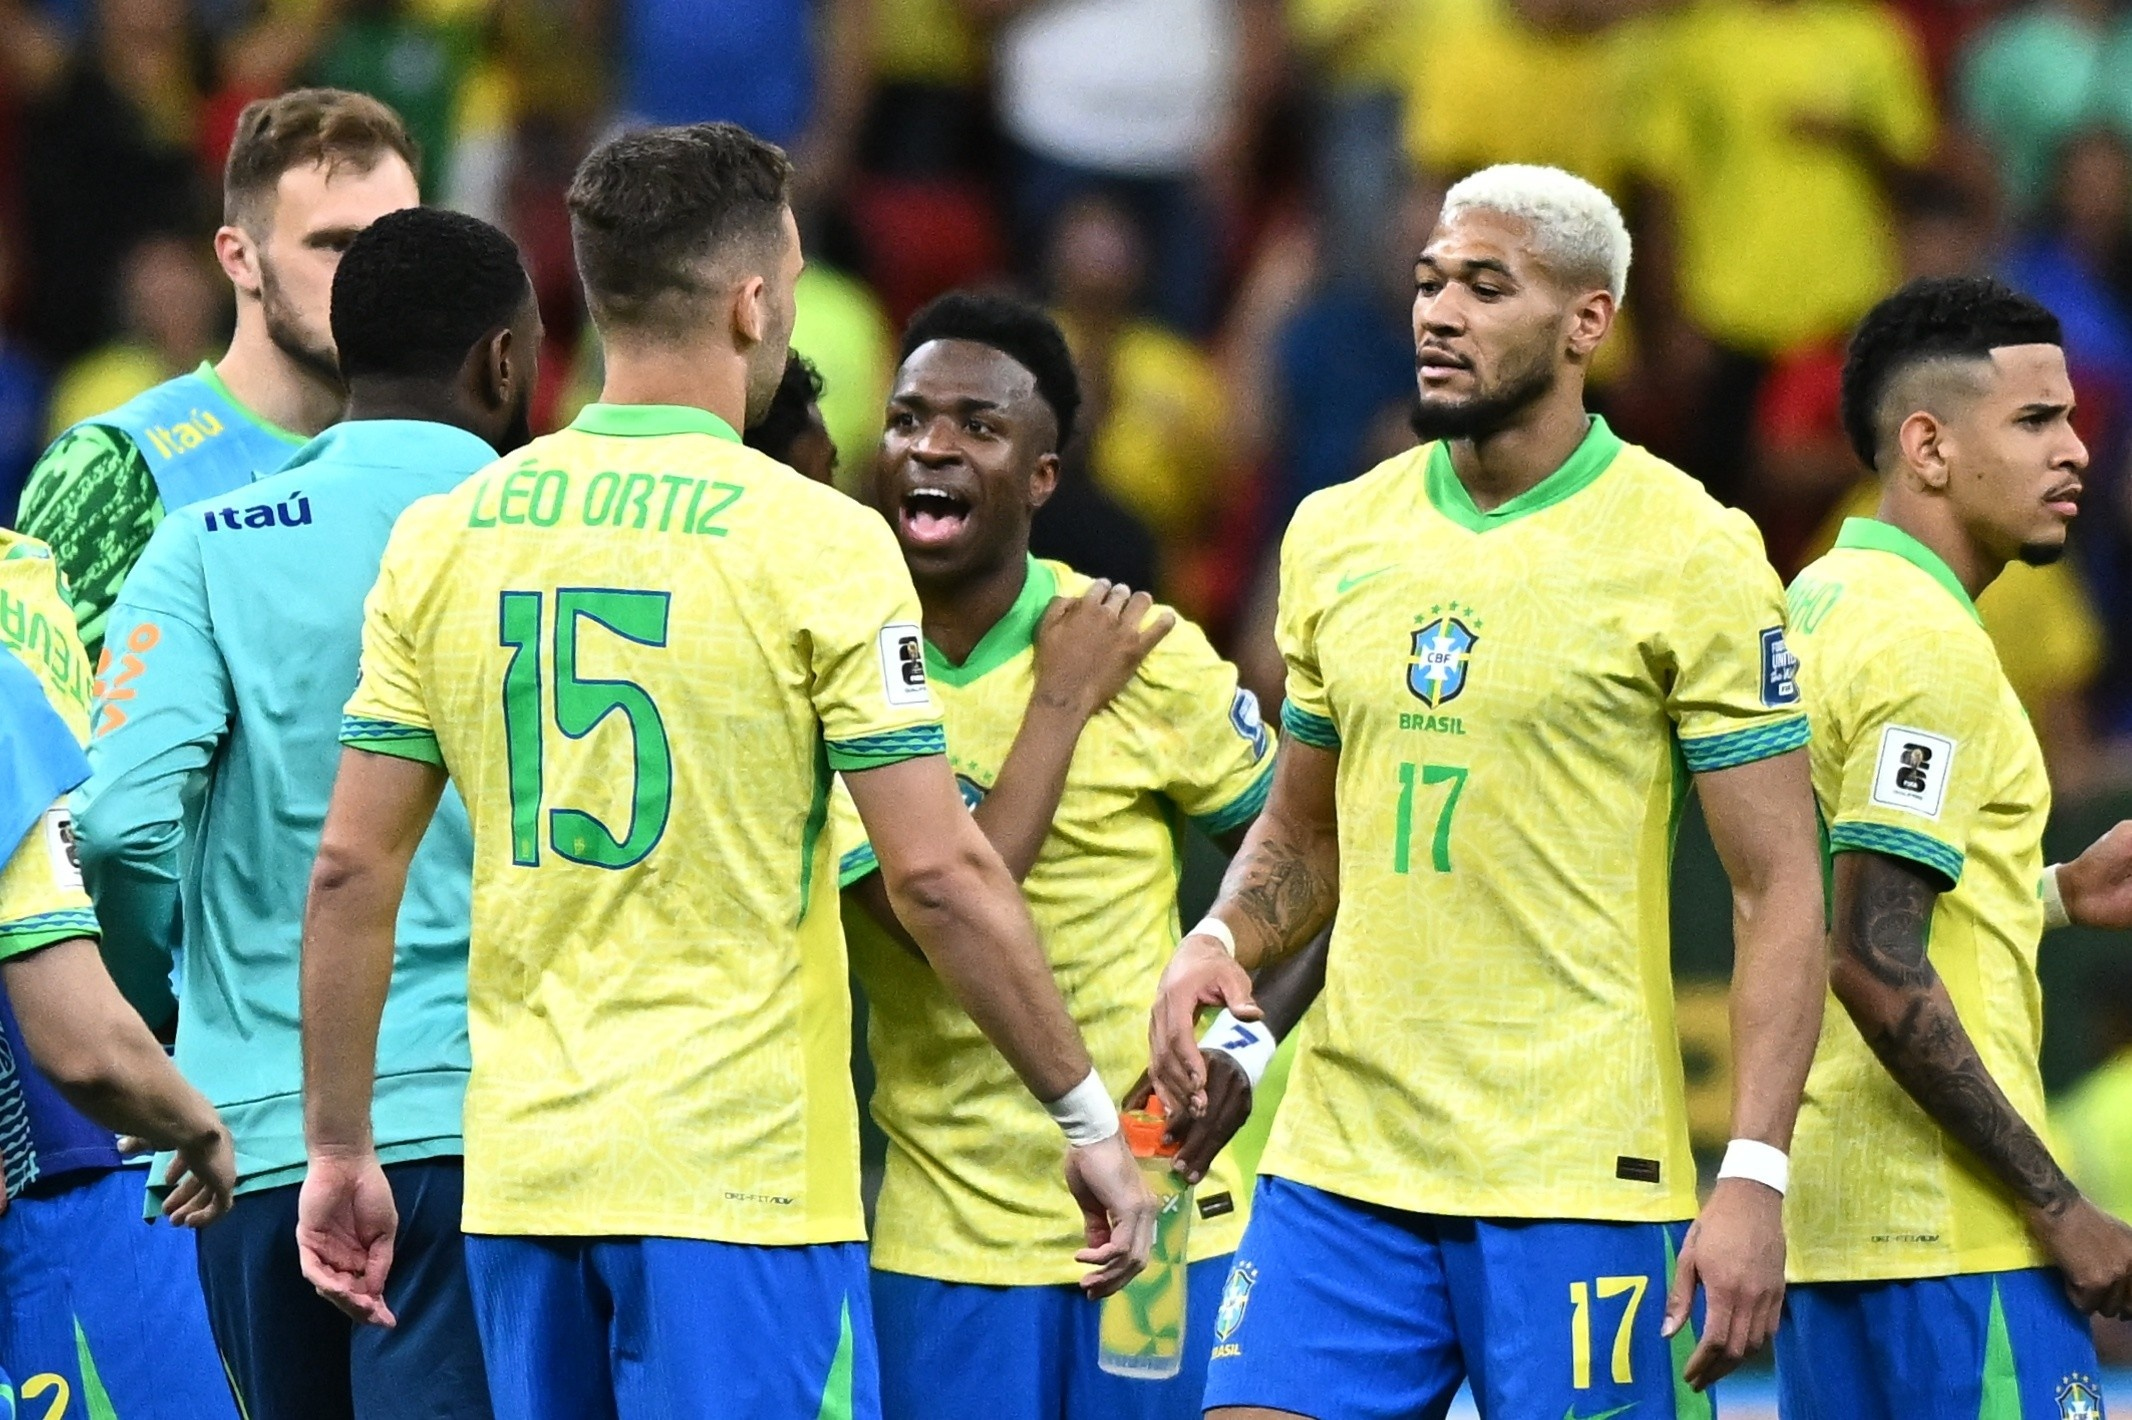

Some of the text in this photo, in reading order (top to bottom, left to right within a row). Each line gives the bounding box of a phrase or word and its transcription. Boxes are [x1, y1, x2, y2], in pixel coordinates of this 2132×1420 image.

[145, 408, 224, 459] Itaú
[203, 490, 312, 532] Itaú
[468, 458, 745, 537] LÉO ORTIZ
[1427, 651, 1451, 664] CBF
[500, 587, 672, 870] 15
[1400, 713, 1466, 735] BRASIL
[1395, 762, 1468, 874] 17
[1221, 1024, 1260, 1050] 7
[1570, 1275, 1649, 1389] 17
